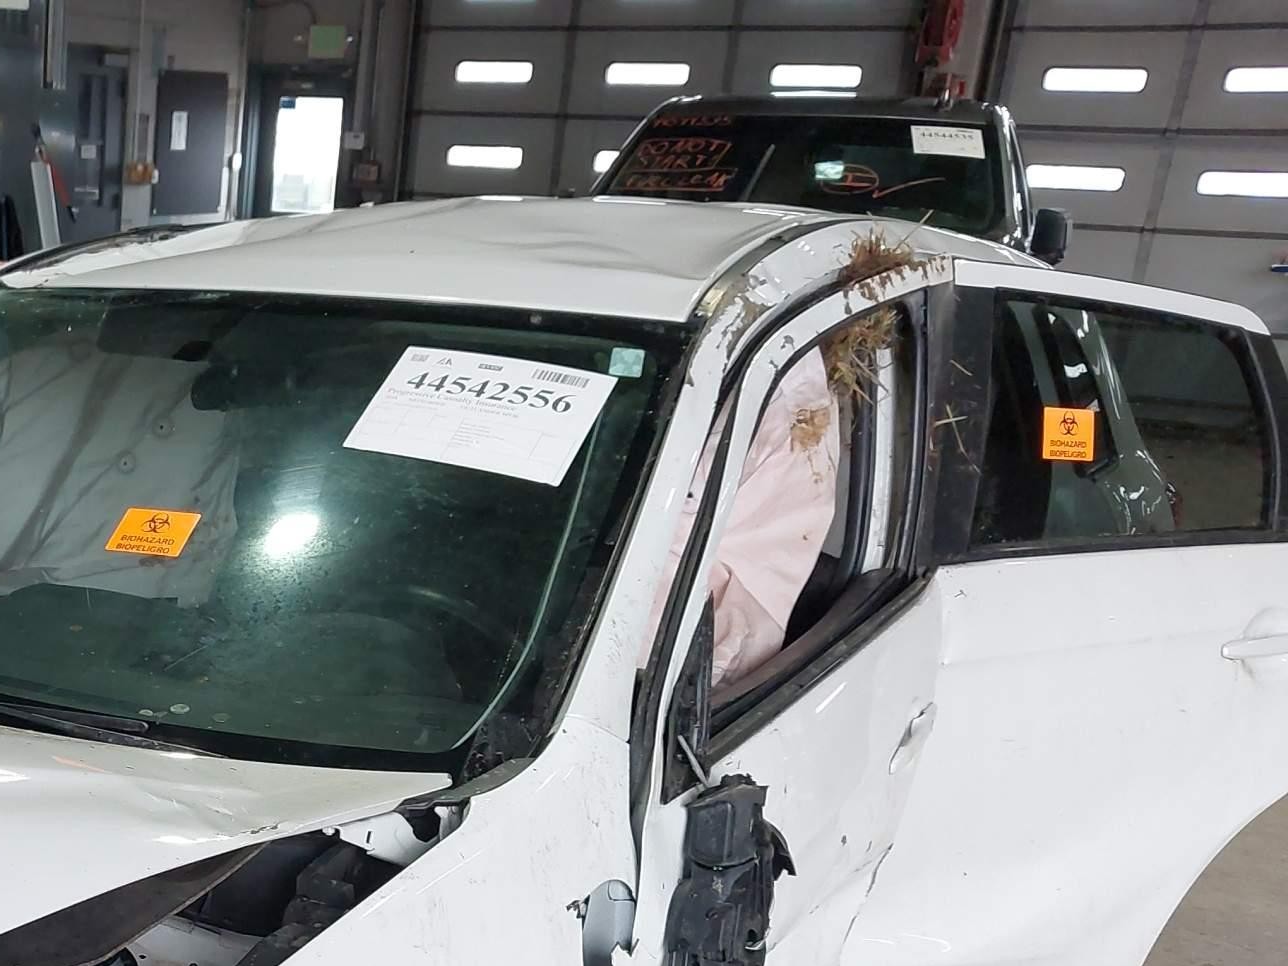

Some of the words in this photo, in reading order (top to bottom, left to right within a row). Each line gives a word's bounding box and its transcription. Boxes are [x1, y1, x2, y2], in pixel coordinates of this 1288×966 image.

[407, 371, 577, 413] 44542556
[1050, 440, 1087, 449] BIOHAZARD
[1050, 450, 1087, 458] BIOPELIGRO
[120, 534, 175, 546] BIOHAZARD
[115, 543, 170, 554] BIOPELIGRO
